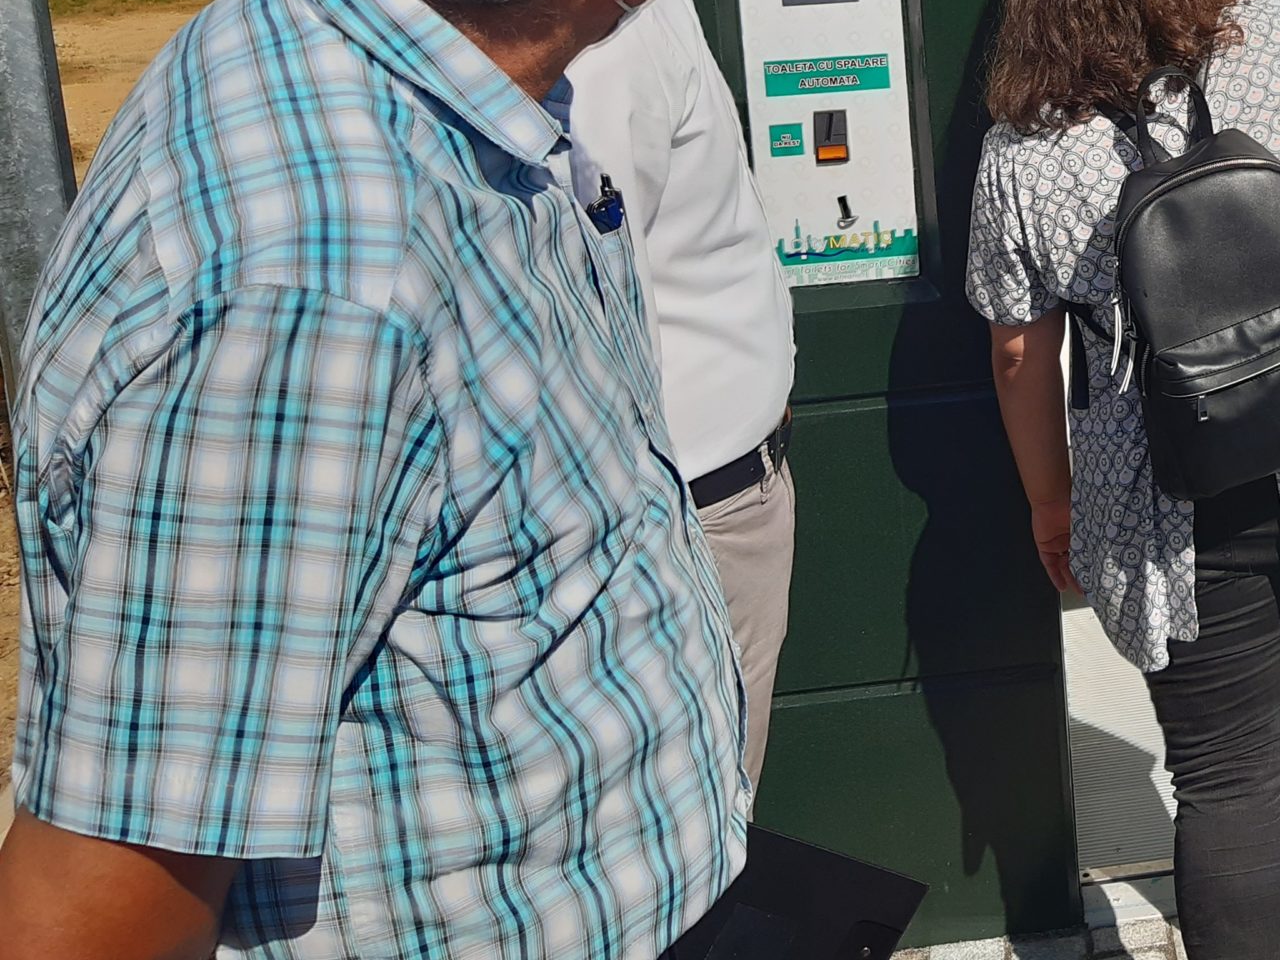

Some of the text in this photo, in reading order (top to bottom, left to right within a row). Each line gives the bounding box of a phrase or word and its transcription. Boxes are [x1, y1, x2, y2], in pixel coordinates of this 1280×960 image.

[765, 58, 887, 74] TOALETA CU SPALARE
[799, 75, 859, 88] AUTOMATA
[836, 263, 851, 271] for
